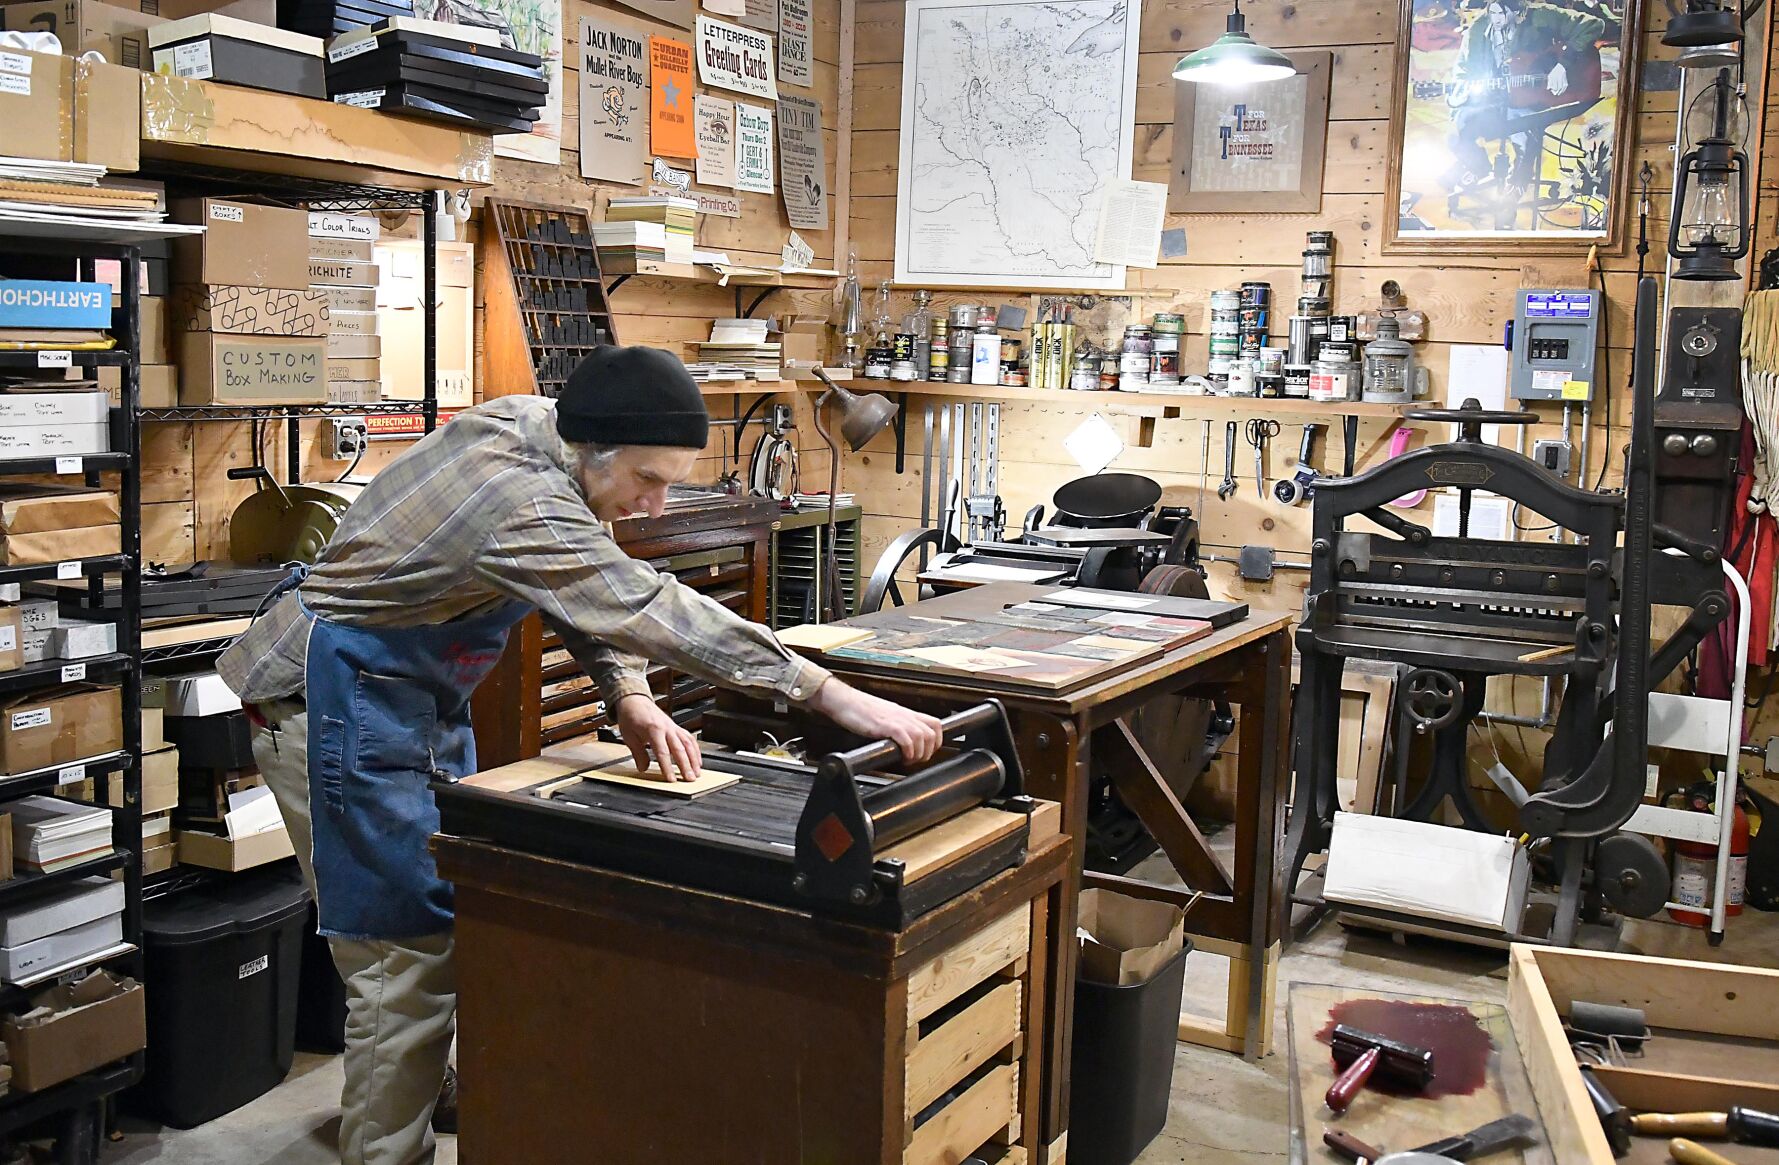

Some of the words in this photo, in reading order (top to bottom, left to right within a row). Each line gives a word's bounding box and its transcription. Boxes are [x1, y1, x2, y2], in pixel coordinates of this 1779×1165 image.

[586, 25, 608, 51] JACK
[610, 31, 642, 60] NORTON
[704, 23, 766, 51] LETTERPRESS
[788, 38, 806, 52] LAST
[660, 43, 689, 58] URBAN
[782, 43, 806, 62] DANCE
[660, 54, 688, 66] HILLBILLY
[660, 61, 689, 74] QUARTET
[705, 39, 742, 79] Greeting
[743, 49, 768, 81] Cards
[586, 54, 607, 77] Mullet
[609, 60, 626, 81] River
[627, 65, 643, 89] Boys
[699, 108, 716, 120] Happy
[716, 111, 730, 121] Hour
[1247, 110, 1265, 119] FOR
[604, 132, 625, 142] APPEARING
[701, 196, 727, 213] Printing
[727, 200, 738, 213] Co.
[0, 288, 102, 308] EARTHCHO
[1035, 337, 1043, 354] DICK
[1053, 337, 1061, 355] DICK
[223, 351, 316, 367] CUSTOM
[259, 368, 315, 384] MAKING
[1284, 374, 1309, 386] perior
[367, 416, 413, 427] PERFECTION
[23, 613, 46, 623] DGES
